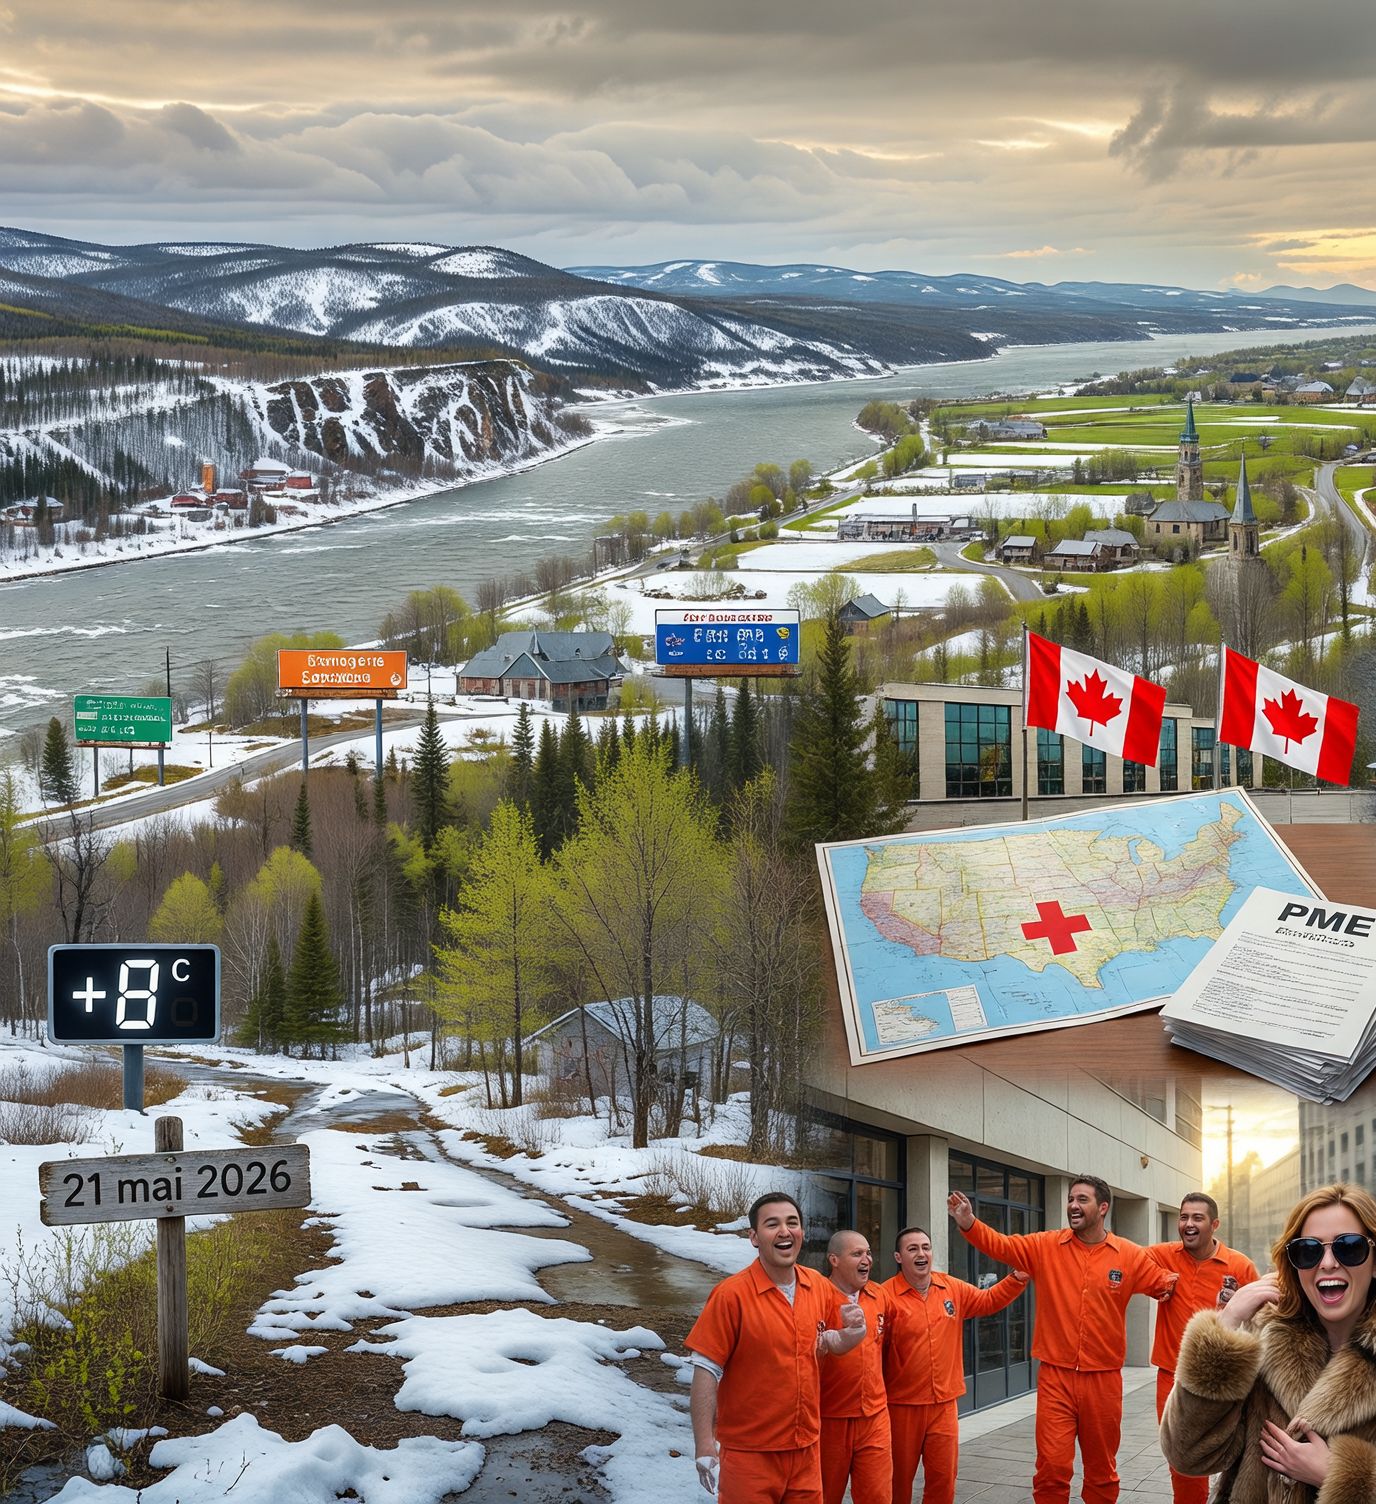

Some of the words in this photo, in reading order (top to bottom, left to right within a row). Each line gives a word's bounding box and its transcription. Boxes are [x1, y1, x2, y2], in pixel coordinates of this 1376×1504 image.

[1277, 902, 1376, 938] PME
[63, 1172, 100, 1208] 21
[118, 1166, 182, 1204] mai
[197, 1159, 291, 1199] 2026
